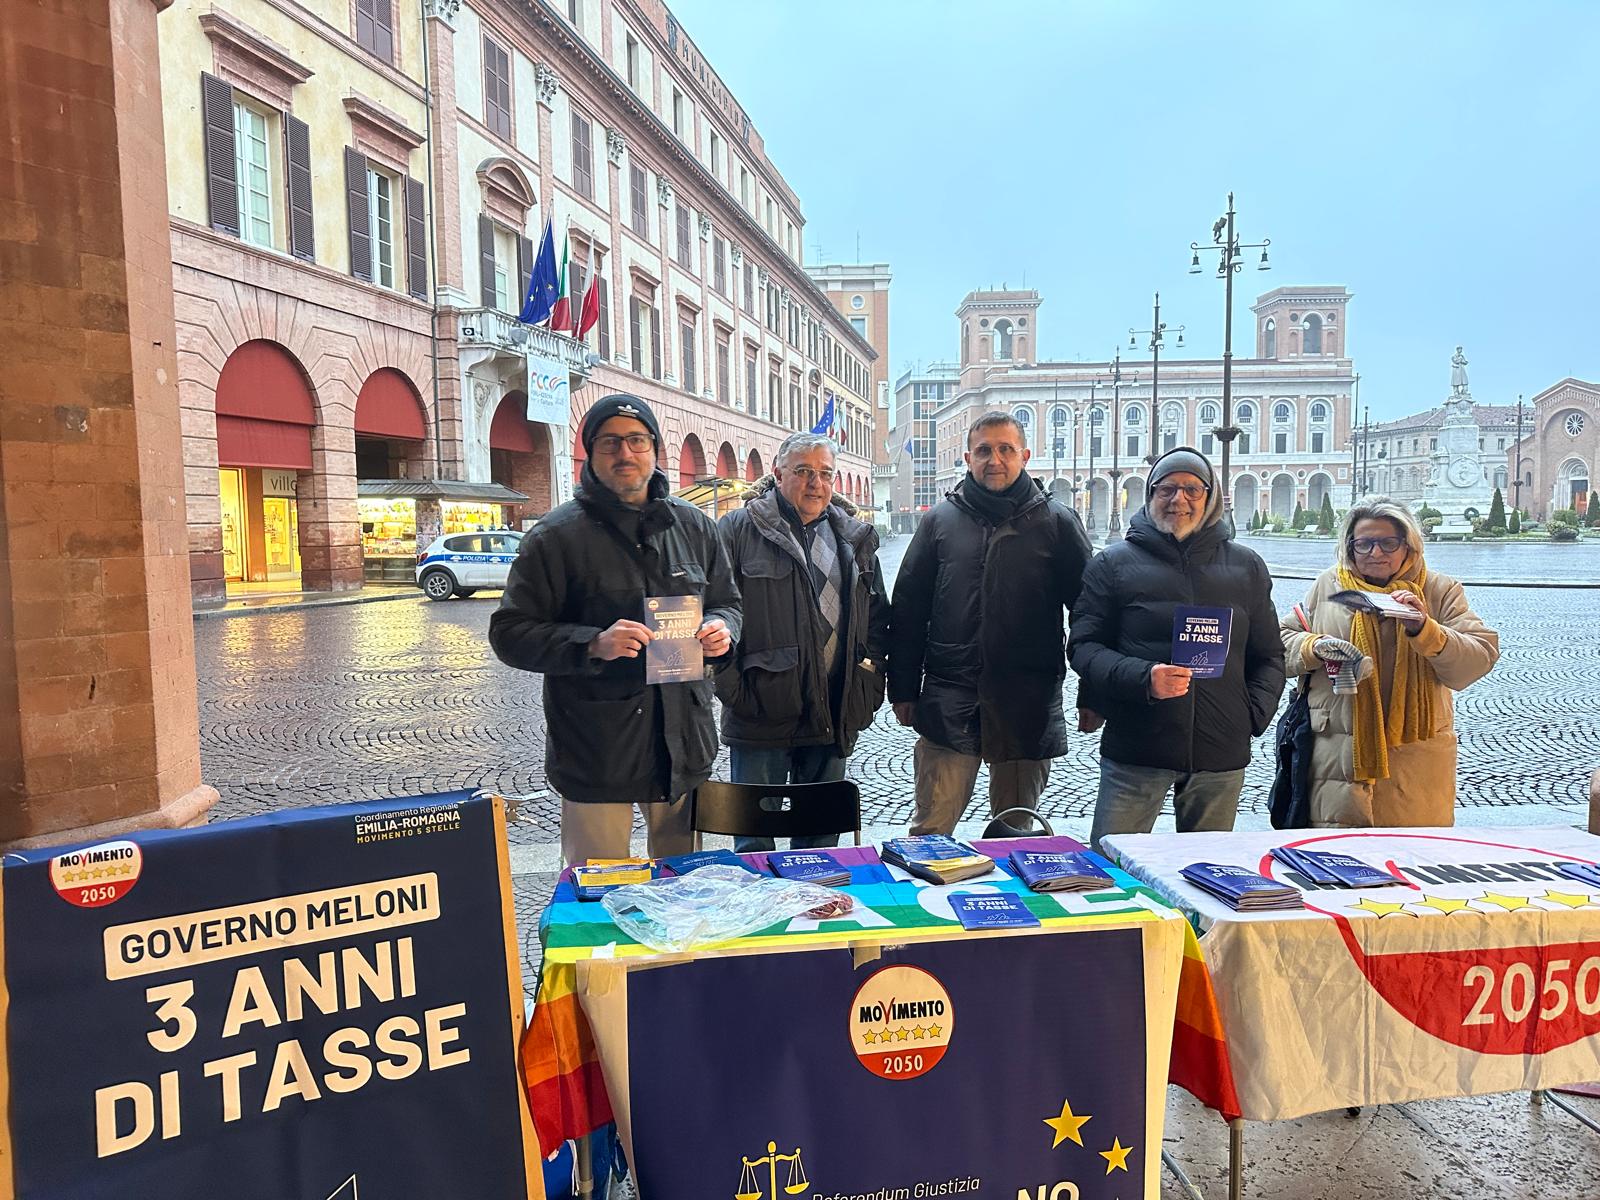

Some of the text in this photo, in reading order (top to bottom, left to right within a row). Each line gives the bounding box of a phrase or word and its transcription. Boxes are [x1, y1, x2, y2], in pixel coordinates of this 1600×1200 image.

[682, 39, 739, 127] MUNICIPIO
[658, 618, 692, 630] 3 ANNI
[1185, 624, 1219, 634] 3 ANNI
[1179, 633, 1224, 643] DI TASSE
[354, 803, 459, 823] Coordinamento Regionale
[356, 811, 460, 835] EMILIA-ROMAGNA
[357, 822, 460, 844] MOVIMENTO 5 STELLE
[60, 848, 133, 867] MOVIMENTO
[81, 886, 115, 903] 2050
[120, 884, 427, 964] GOVERNO MELONI
[146, 937, 416, 1053] 3 ANNI
[1461, 956, 1600, 1026] 2050
[860, 997, 944, 1024] MOVIMENTO
[884, 1054, 923, 1074] 2050
[95, 1003, 470, 1158] DI TASSE
[812, 1176, 980, 1200] frendum Giustizia
